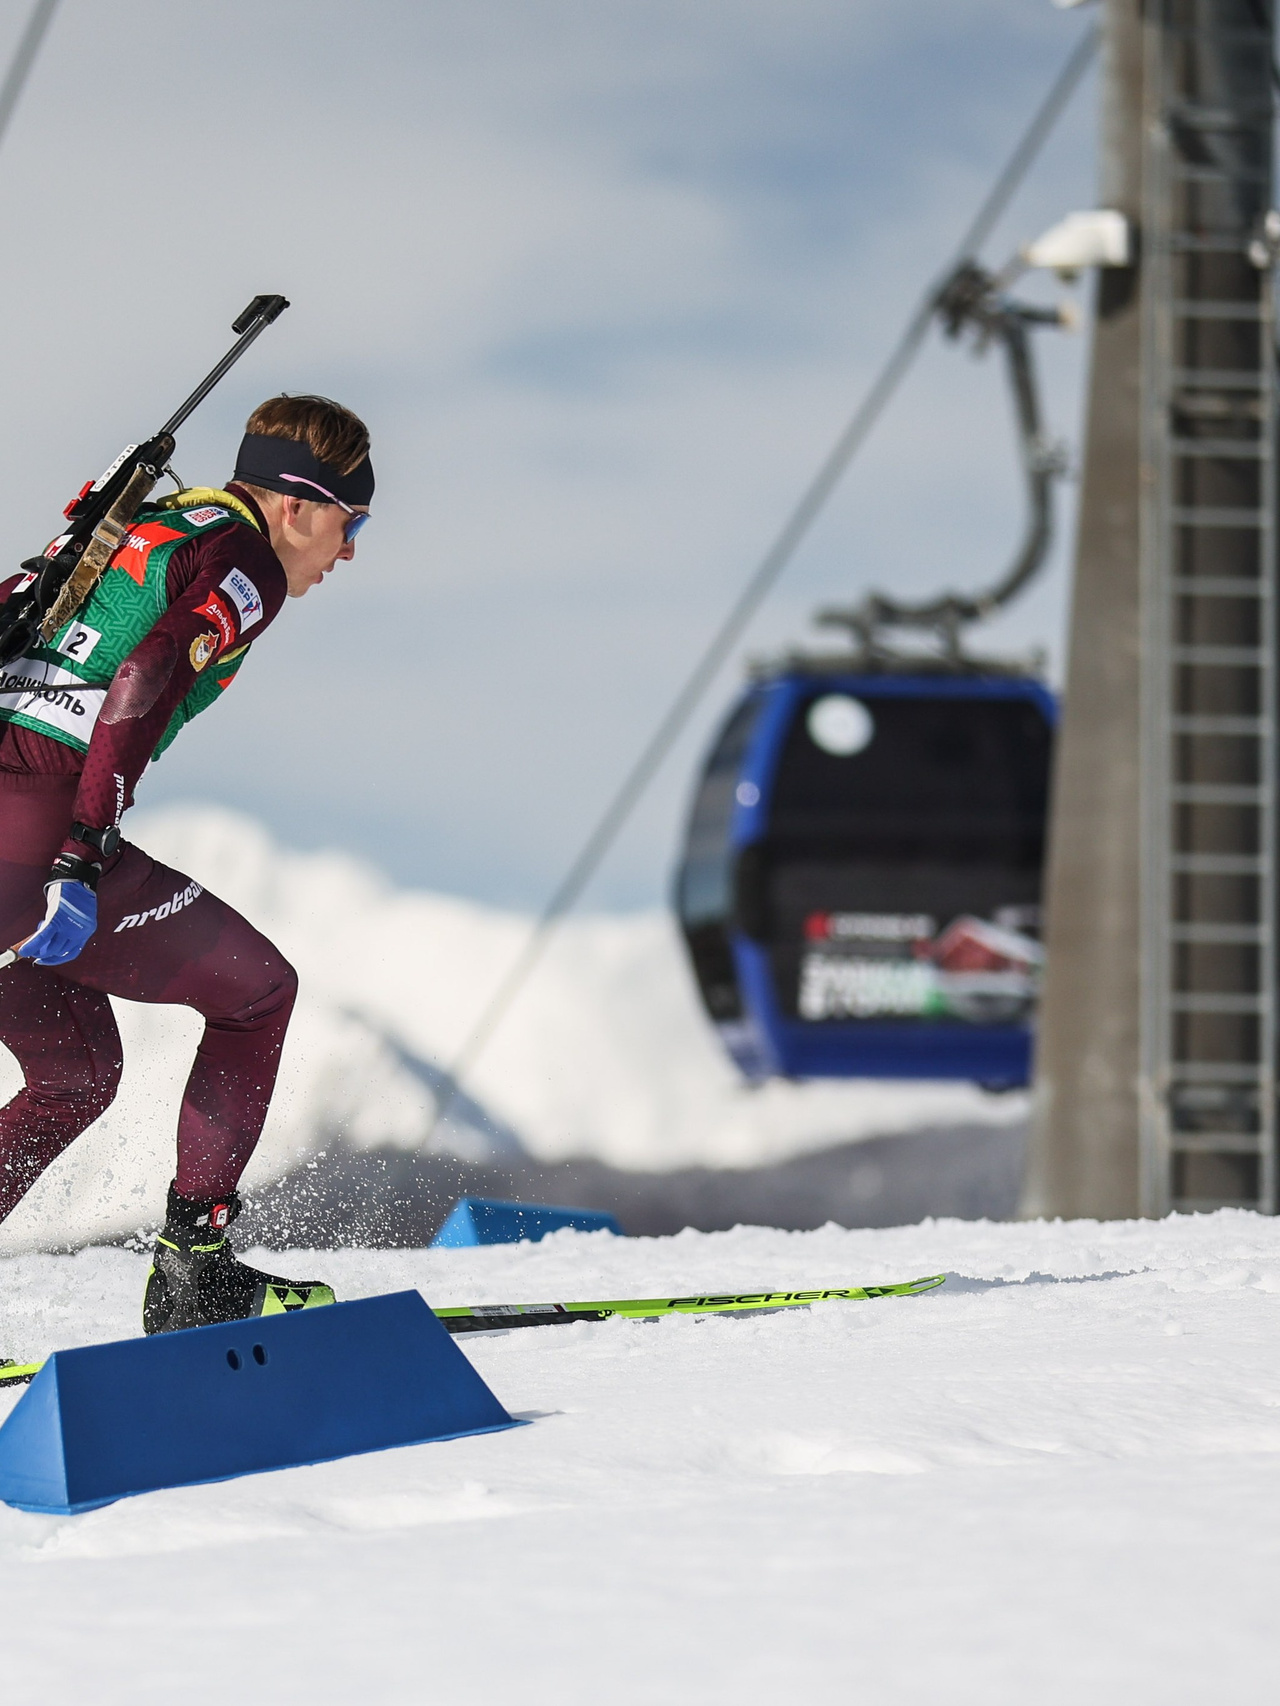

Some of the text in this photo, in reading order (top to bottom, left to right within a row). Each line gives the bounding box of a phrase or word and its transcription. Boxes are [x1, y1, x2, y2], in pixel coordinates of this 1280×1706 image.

[230, 575, 251, 602] СБР
[66, 631, 88, 656] 2
[666, 1289, 850, 1308] FISCHER
